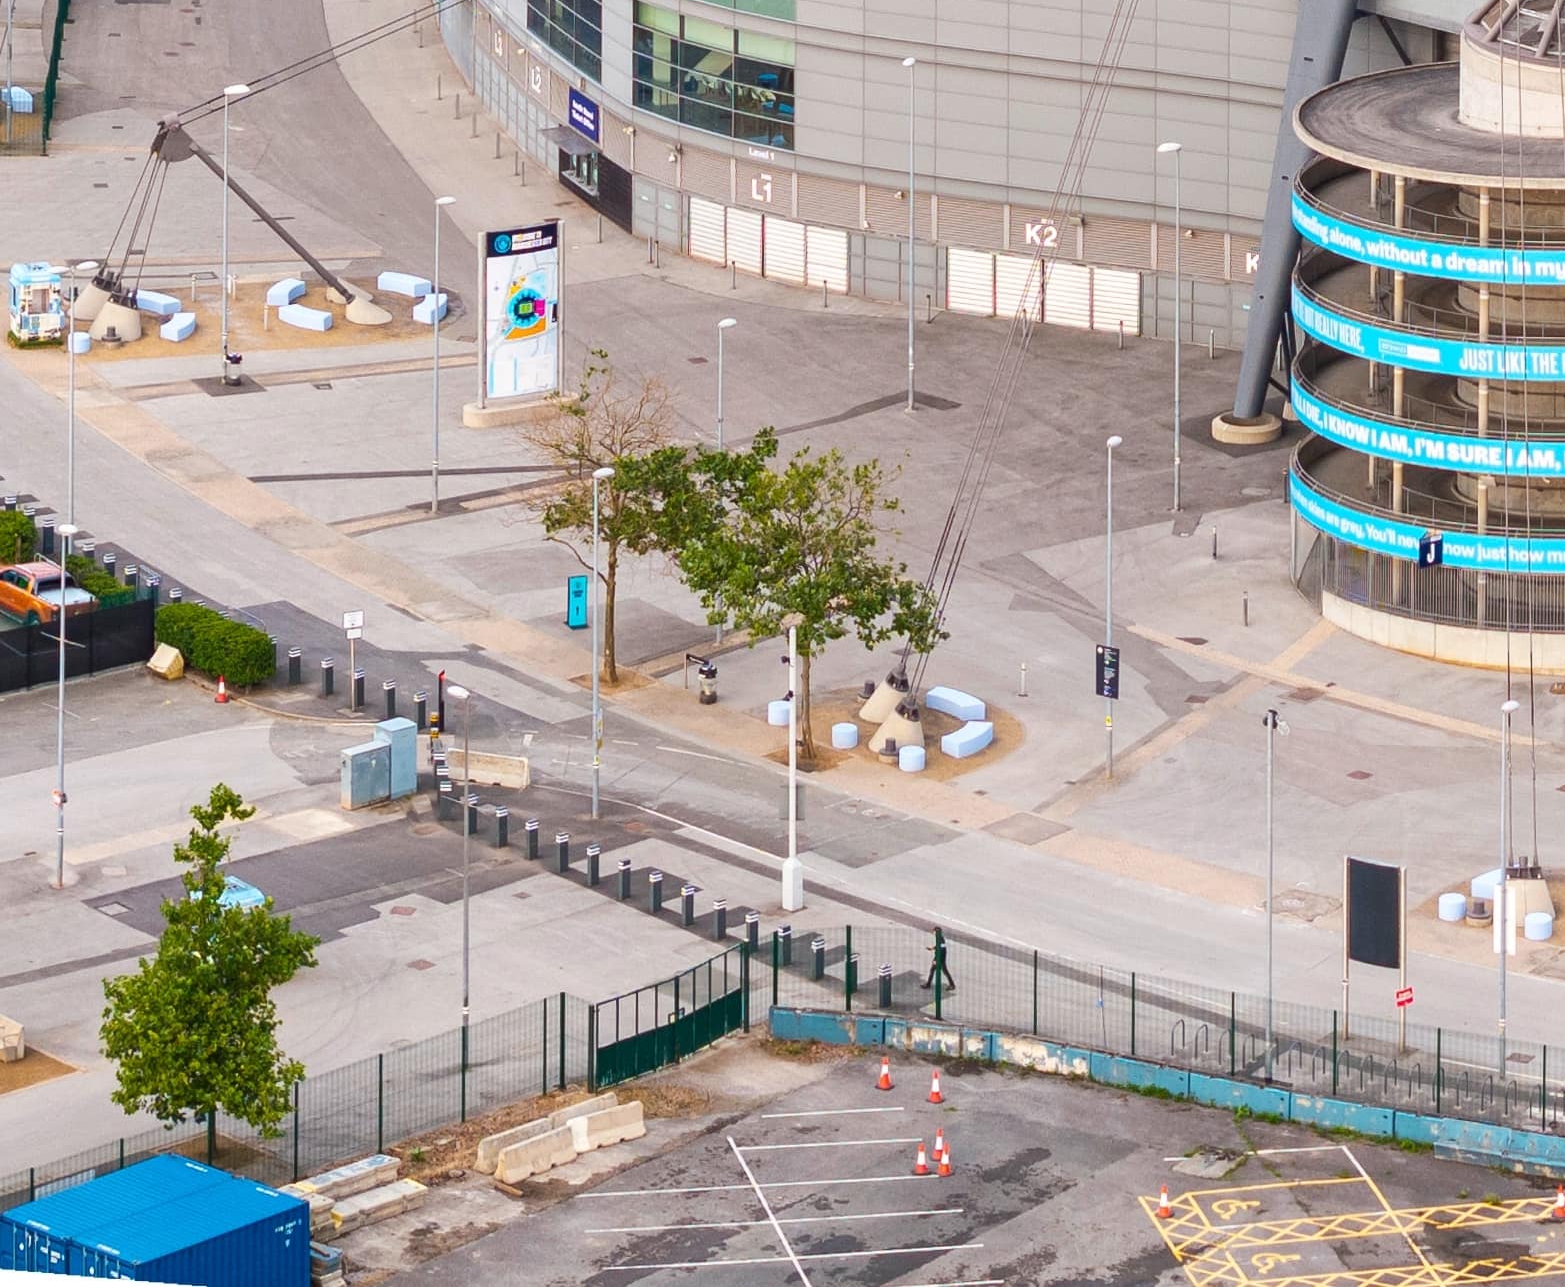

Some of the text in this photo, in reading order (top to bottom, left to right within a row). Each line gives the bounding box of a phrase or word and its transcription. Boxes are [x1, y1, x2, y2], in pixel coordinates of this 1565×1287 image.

[751, 179, 773, 203] L1
[1026, 223, 1058, 248] K2
[1329, 228, 1365, 256] alone,
[1365, 242, 1428, 267] without
[1431, 254, 1443, 268] a
[1445, 252, 1506, 274] dream
[1512, 256, 1531, 275] in
[1459, 348, 1495, 371] JUST
[1497, 351, 1526, 373] LIKE
[1531, 352, 1559, 374] THE
[1328, 412, 1369, 444] KNOW
[1371, 431, 1377, 447] I
[1378, 434, 1412, 458] AM,
[1414, 437, 1445, 459] I'M
[1447, 442, 1503, 467] SURE
[1516, 449, 1561, 471] AM,
[1366, 524, 1396, 545] You'll
[1397, 534, 1420, 548] nev
[1443, 543, 1475, 559] now
[1477, 544, 1507, 569] just
[1509, 544, 1544, 563] how
[1427, 542, 1436, 564] J
